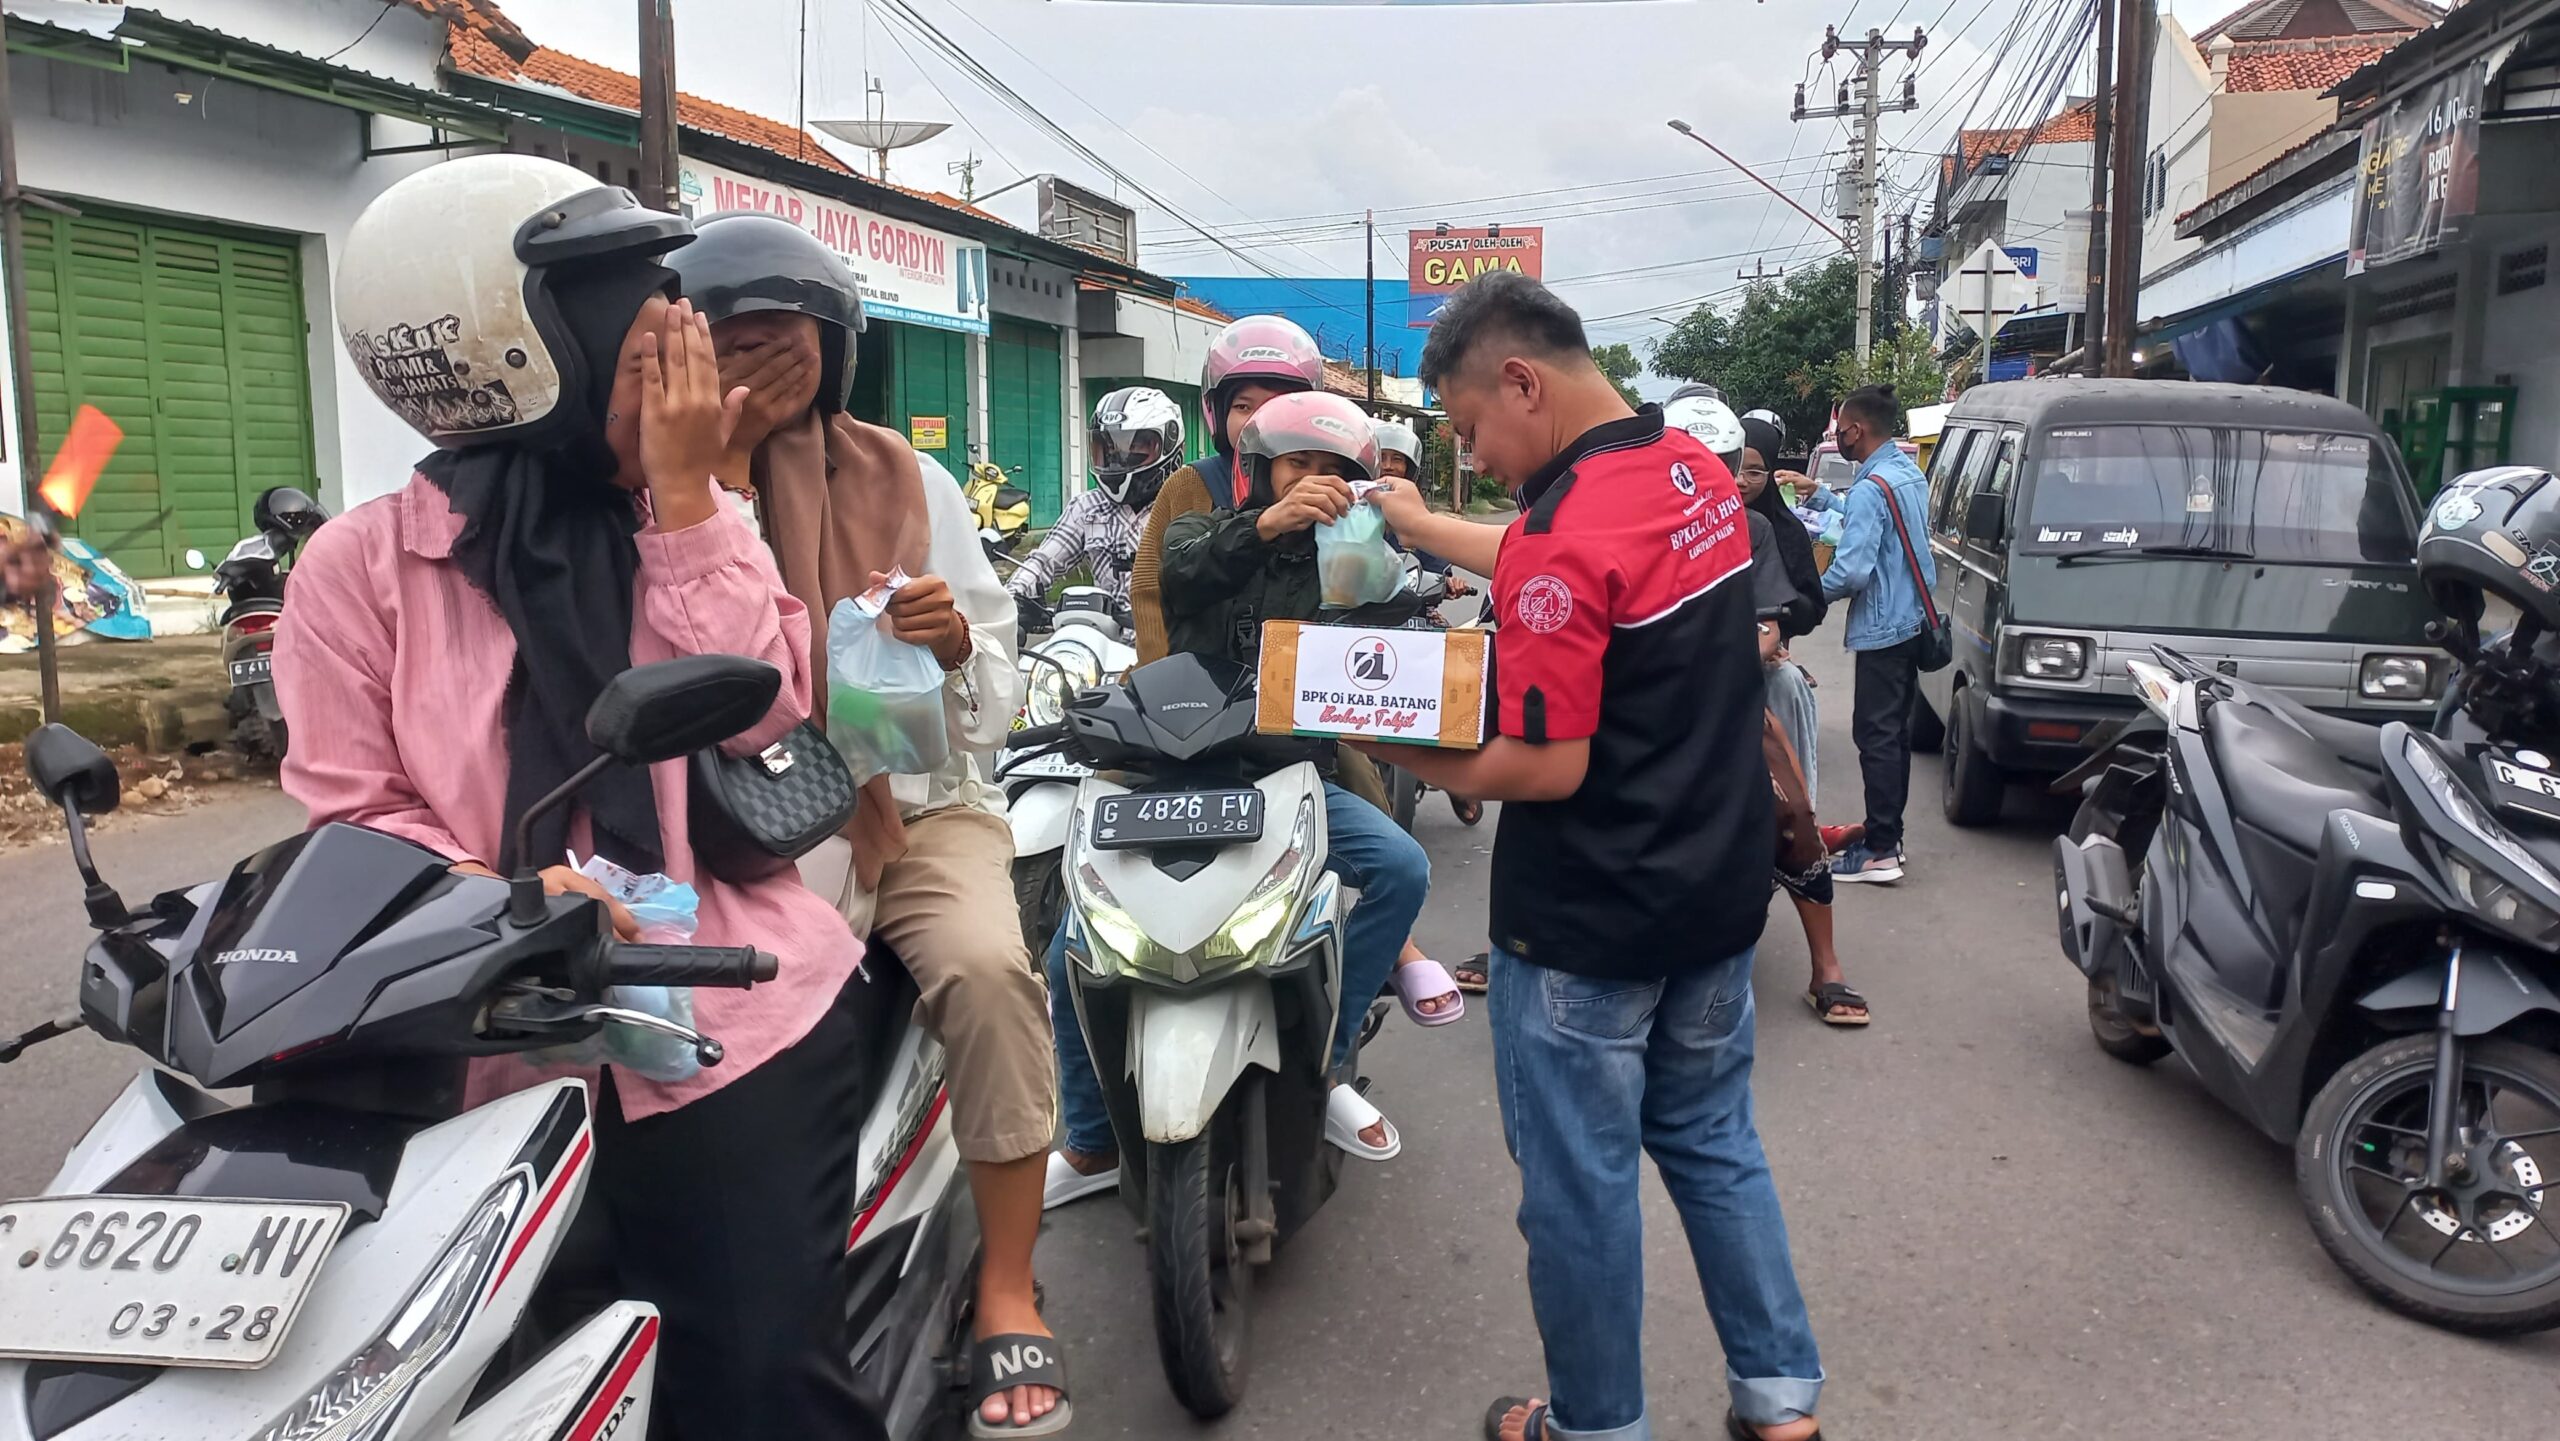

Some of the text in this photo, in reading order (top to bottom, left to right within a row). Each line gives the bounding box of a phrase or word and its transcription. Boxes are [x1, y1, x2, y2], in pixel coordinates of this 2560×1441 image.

[810, 205, 863, 257] JAYA
[867, 220, 945, 276] GORDYN
[1429, 237, 1523, 251] PUSAT OLEH-OLEH
[1424, 256, 1525, 285] GAMA
[2012, 256, 2032, 268] BRI
[1241, 349, 1285, 359] INK
[1161, 701, 1209, 712] HONDA
[1302, 690, 1437, 711] BPK Oi KAB. BATANG
[1319, 704, 1371, 731] Berbagi
[2539, 777, 2560, 796] 6
[1103, 794, 1253, 824] G 4826 FV
[2339, 814, 2361, 851] HONDA
[212, 948, 299, 965] HONDA
[44, 1210, 326, 1278] 6620 NV
